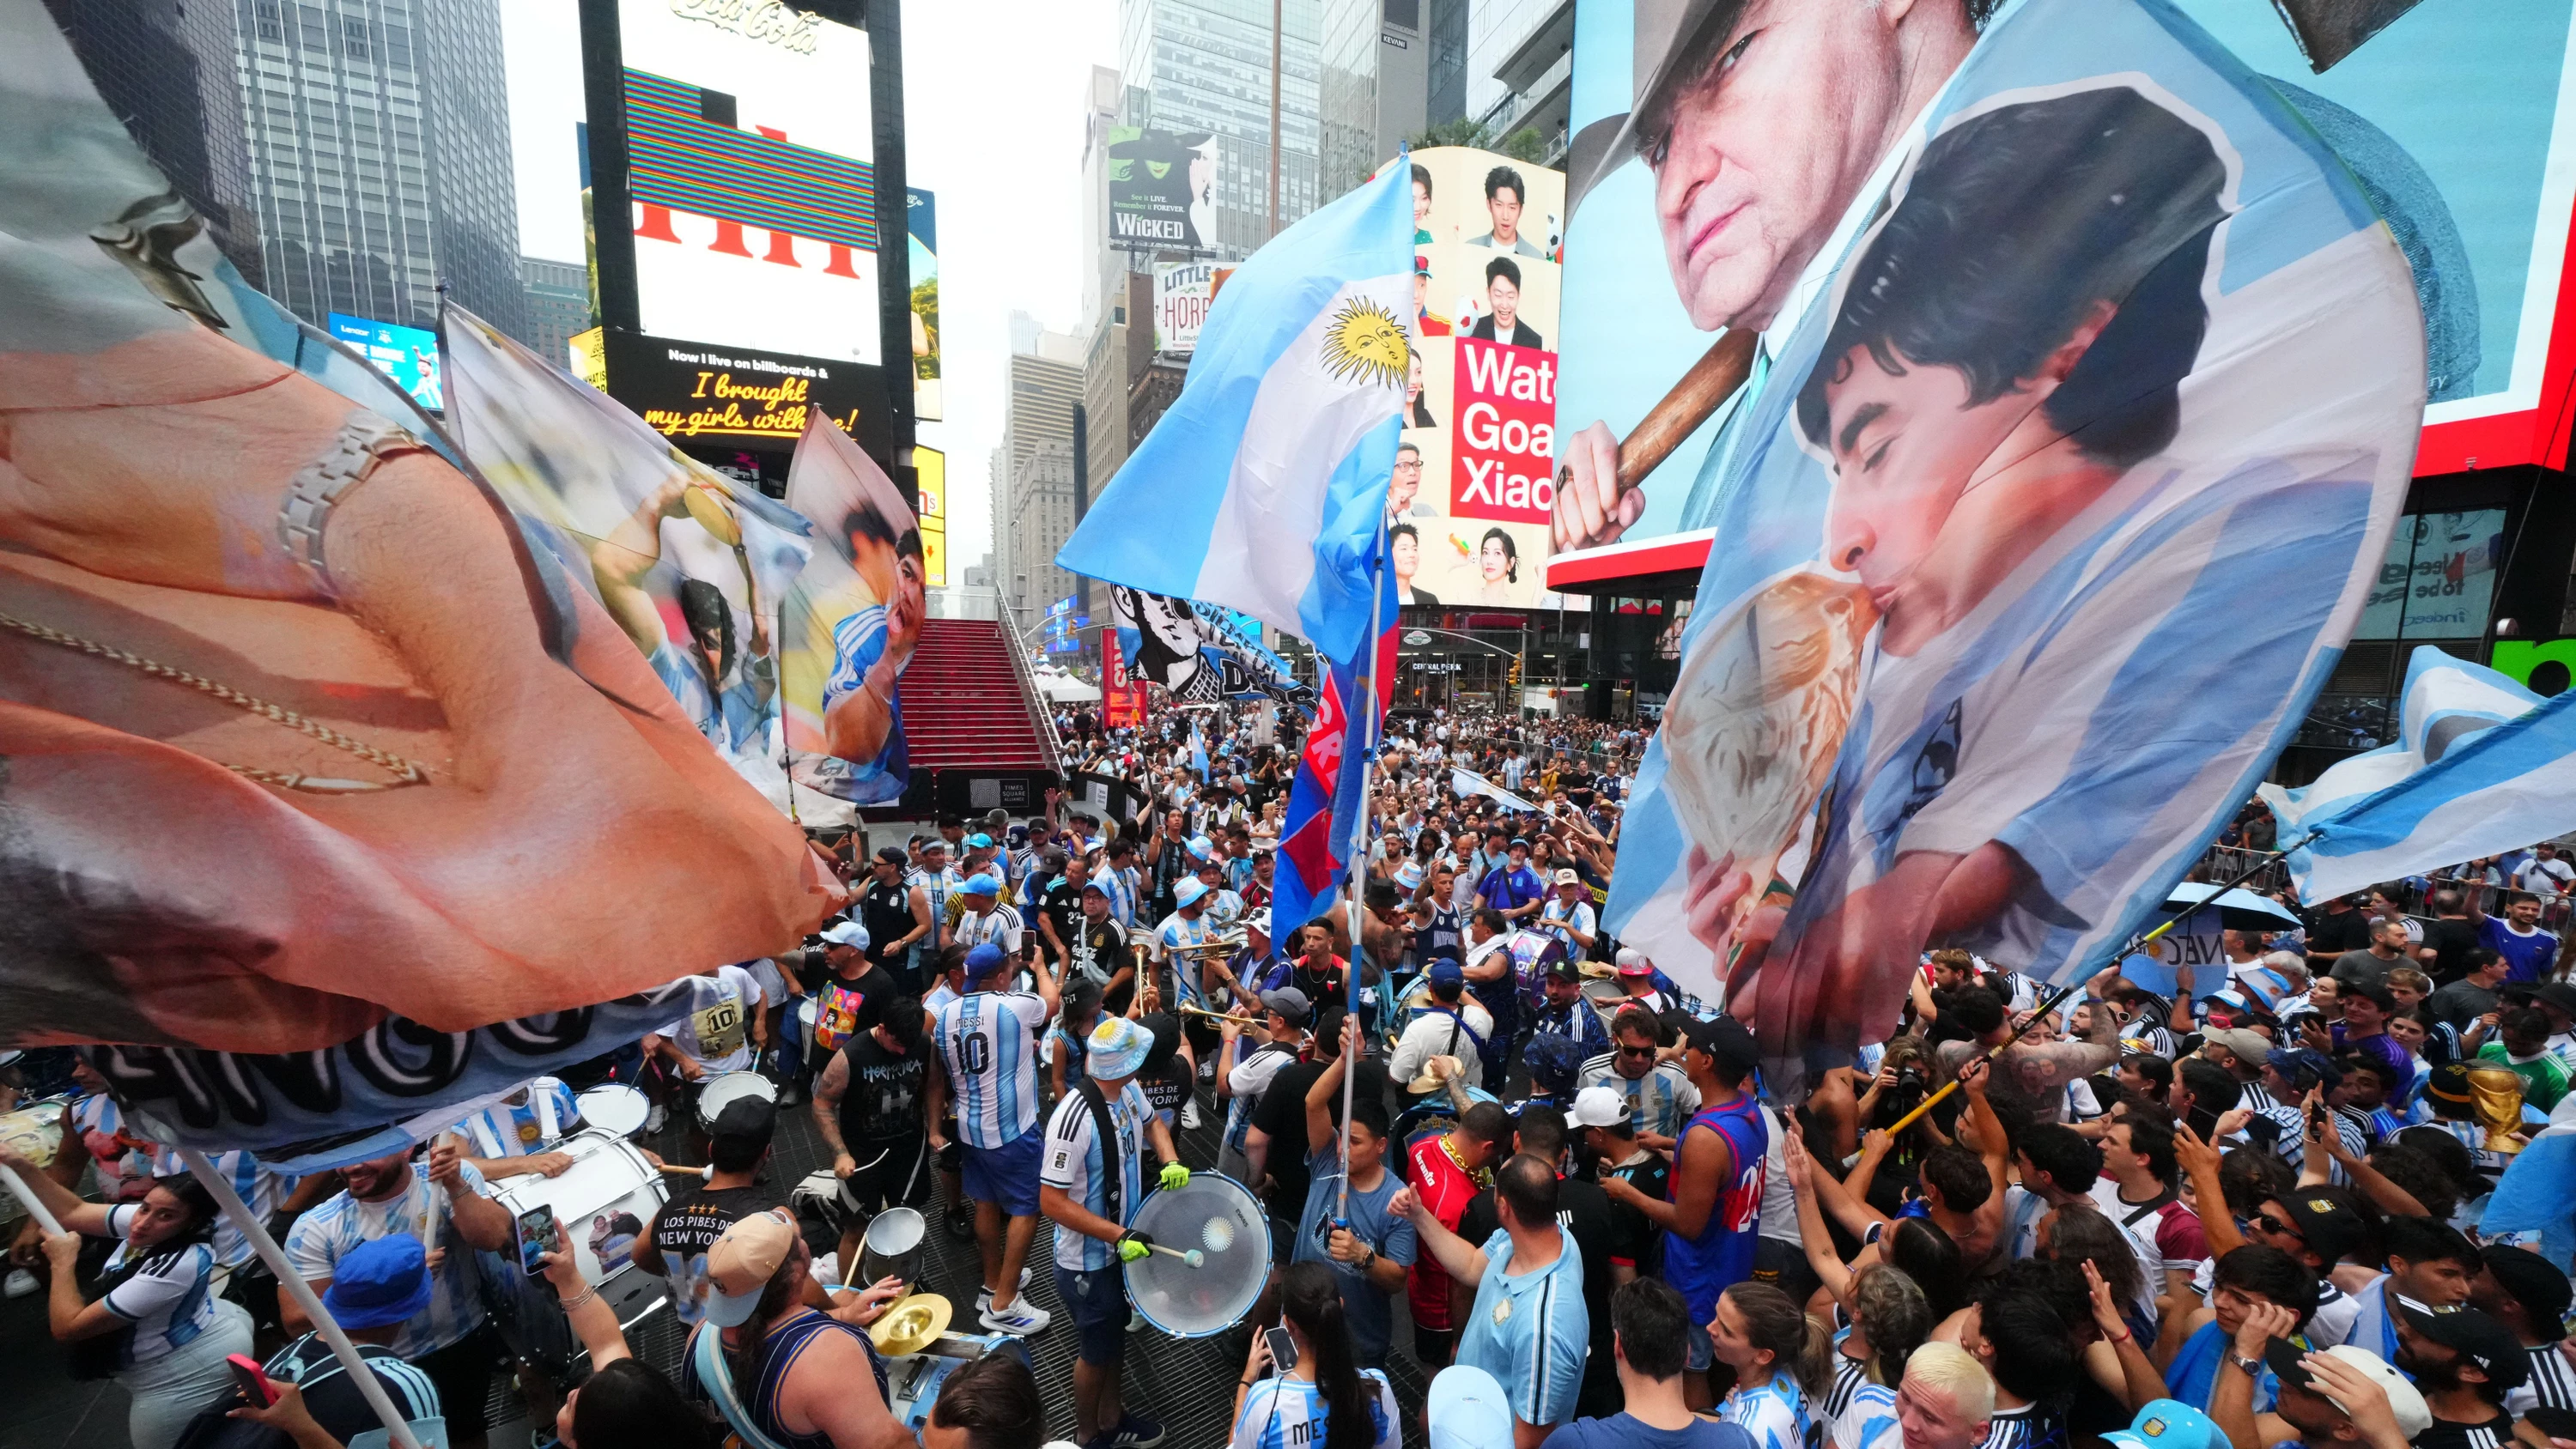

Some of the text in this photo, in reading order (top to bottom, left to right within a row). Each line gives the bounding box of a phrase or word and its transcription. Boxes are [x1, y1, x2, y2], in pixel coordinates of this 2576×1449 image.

[1383, 36, 1406, 48] KEVANI
[1114, 201, 1145, 209] Remember
[1164, 266, 1212, 293] LITTLE
[668, 349, 829, 379] Now I live on billboards &
[690, 372, 809, 410] I brought
[645, 409, 686, 436] my
[688, 403, 749, 436] girls
[752, 405, 806, 430] with
[711, 1009, 733, 1032] 10
[955, 1016, 985, 1028] MESSI
[952, 1031, 989, 1076] 10
[1142, 1085, 1179, 1095] IBES DE
[1147, 1094, 1181, 1106] YORK
[1415, 1149, 1436, 1187] taranto
[664, 1216, 685, 1229] LOS
[686, 1216, 717, 1231] PIBES
[659, 1230, 691, 1246] NEW
